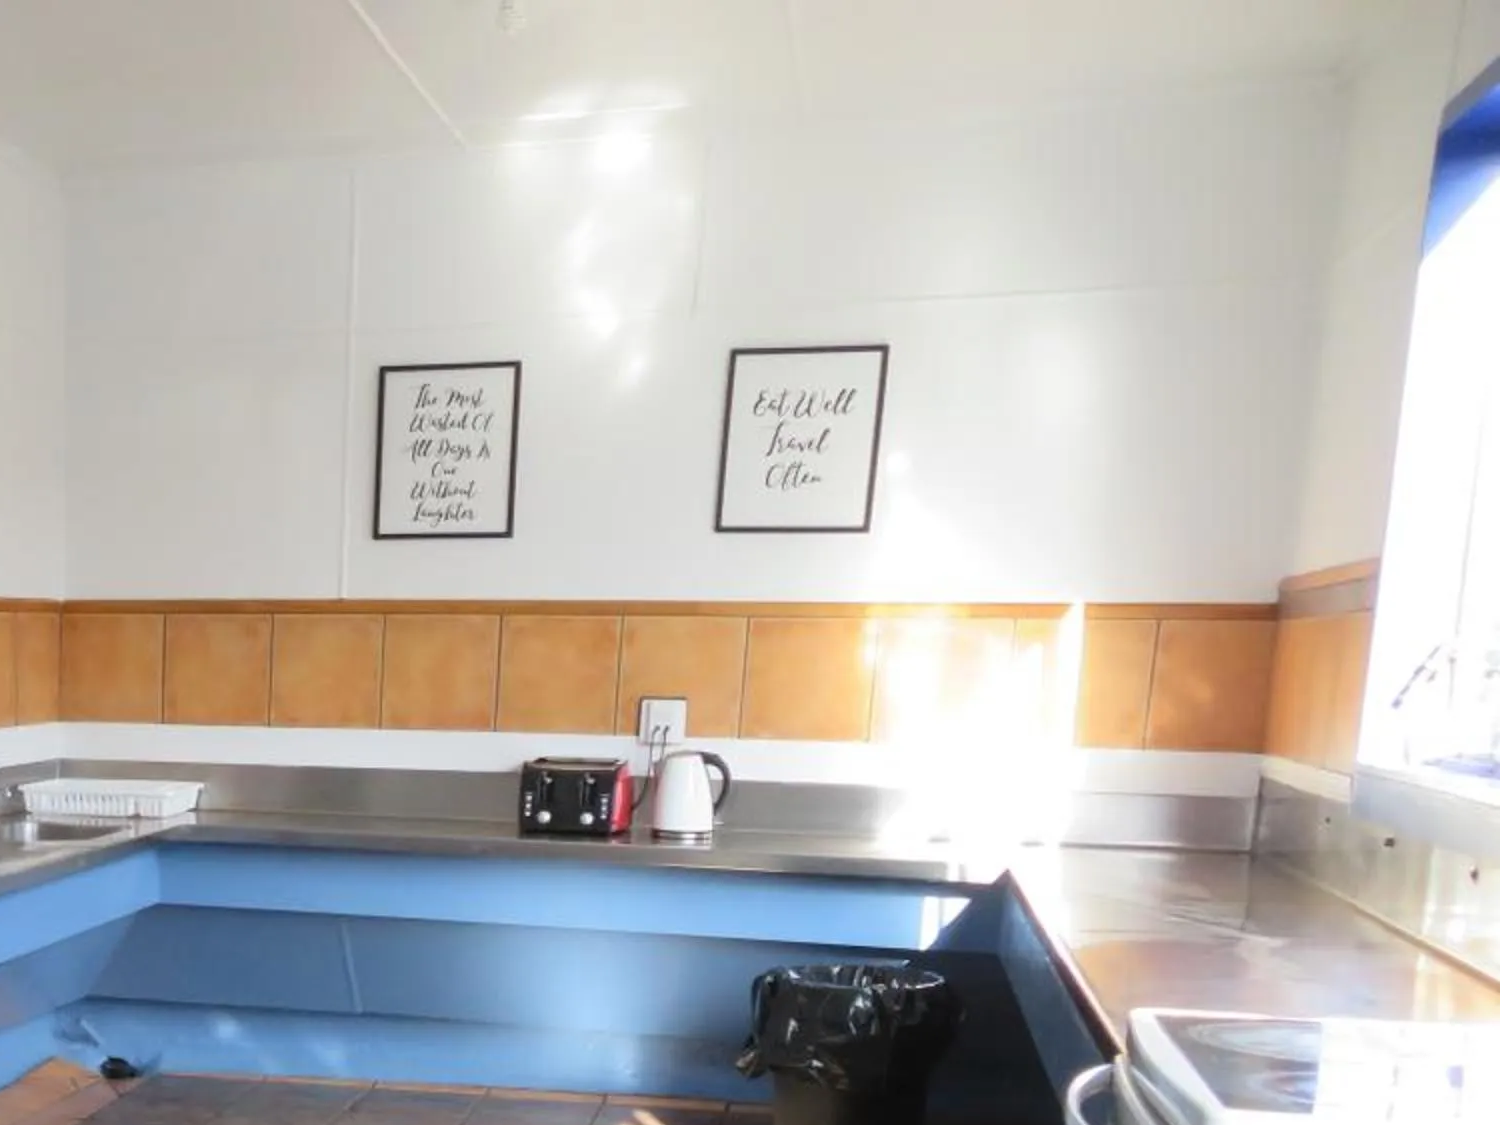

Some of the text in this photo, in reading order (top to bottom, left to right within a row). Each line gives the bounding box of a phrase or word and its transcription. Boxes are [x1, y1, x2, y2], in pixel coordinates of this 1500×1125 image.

[412, 383, 484, 409] The Most
[752, 388, 857, 418] Eat Well
[760, 420, 831, 456] Travel
[408, 480, 476, 499] Without
[764, 461, 822, 490] Often
